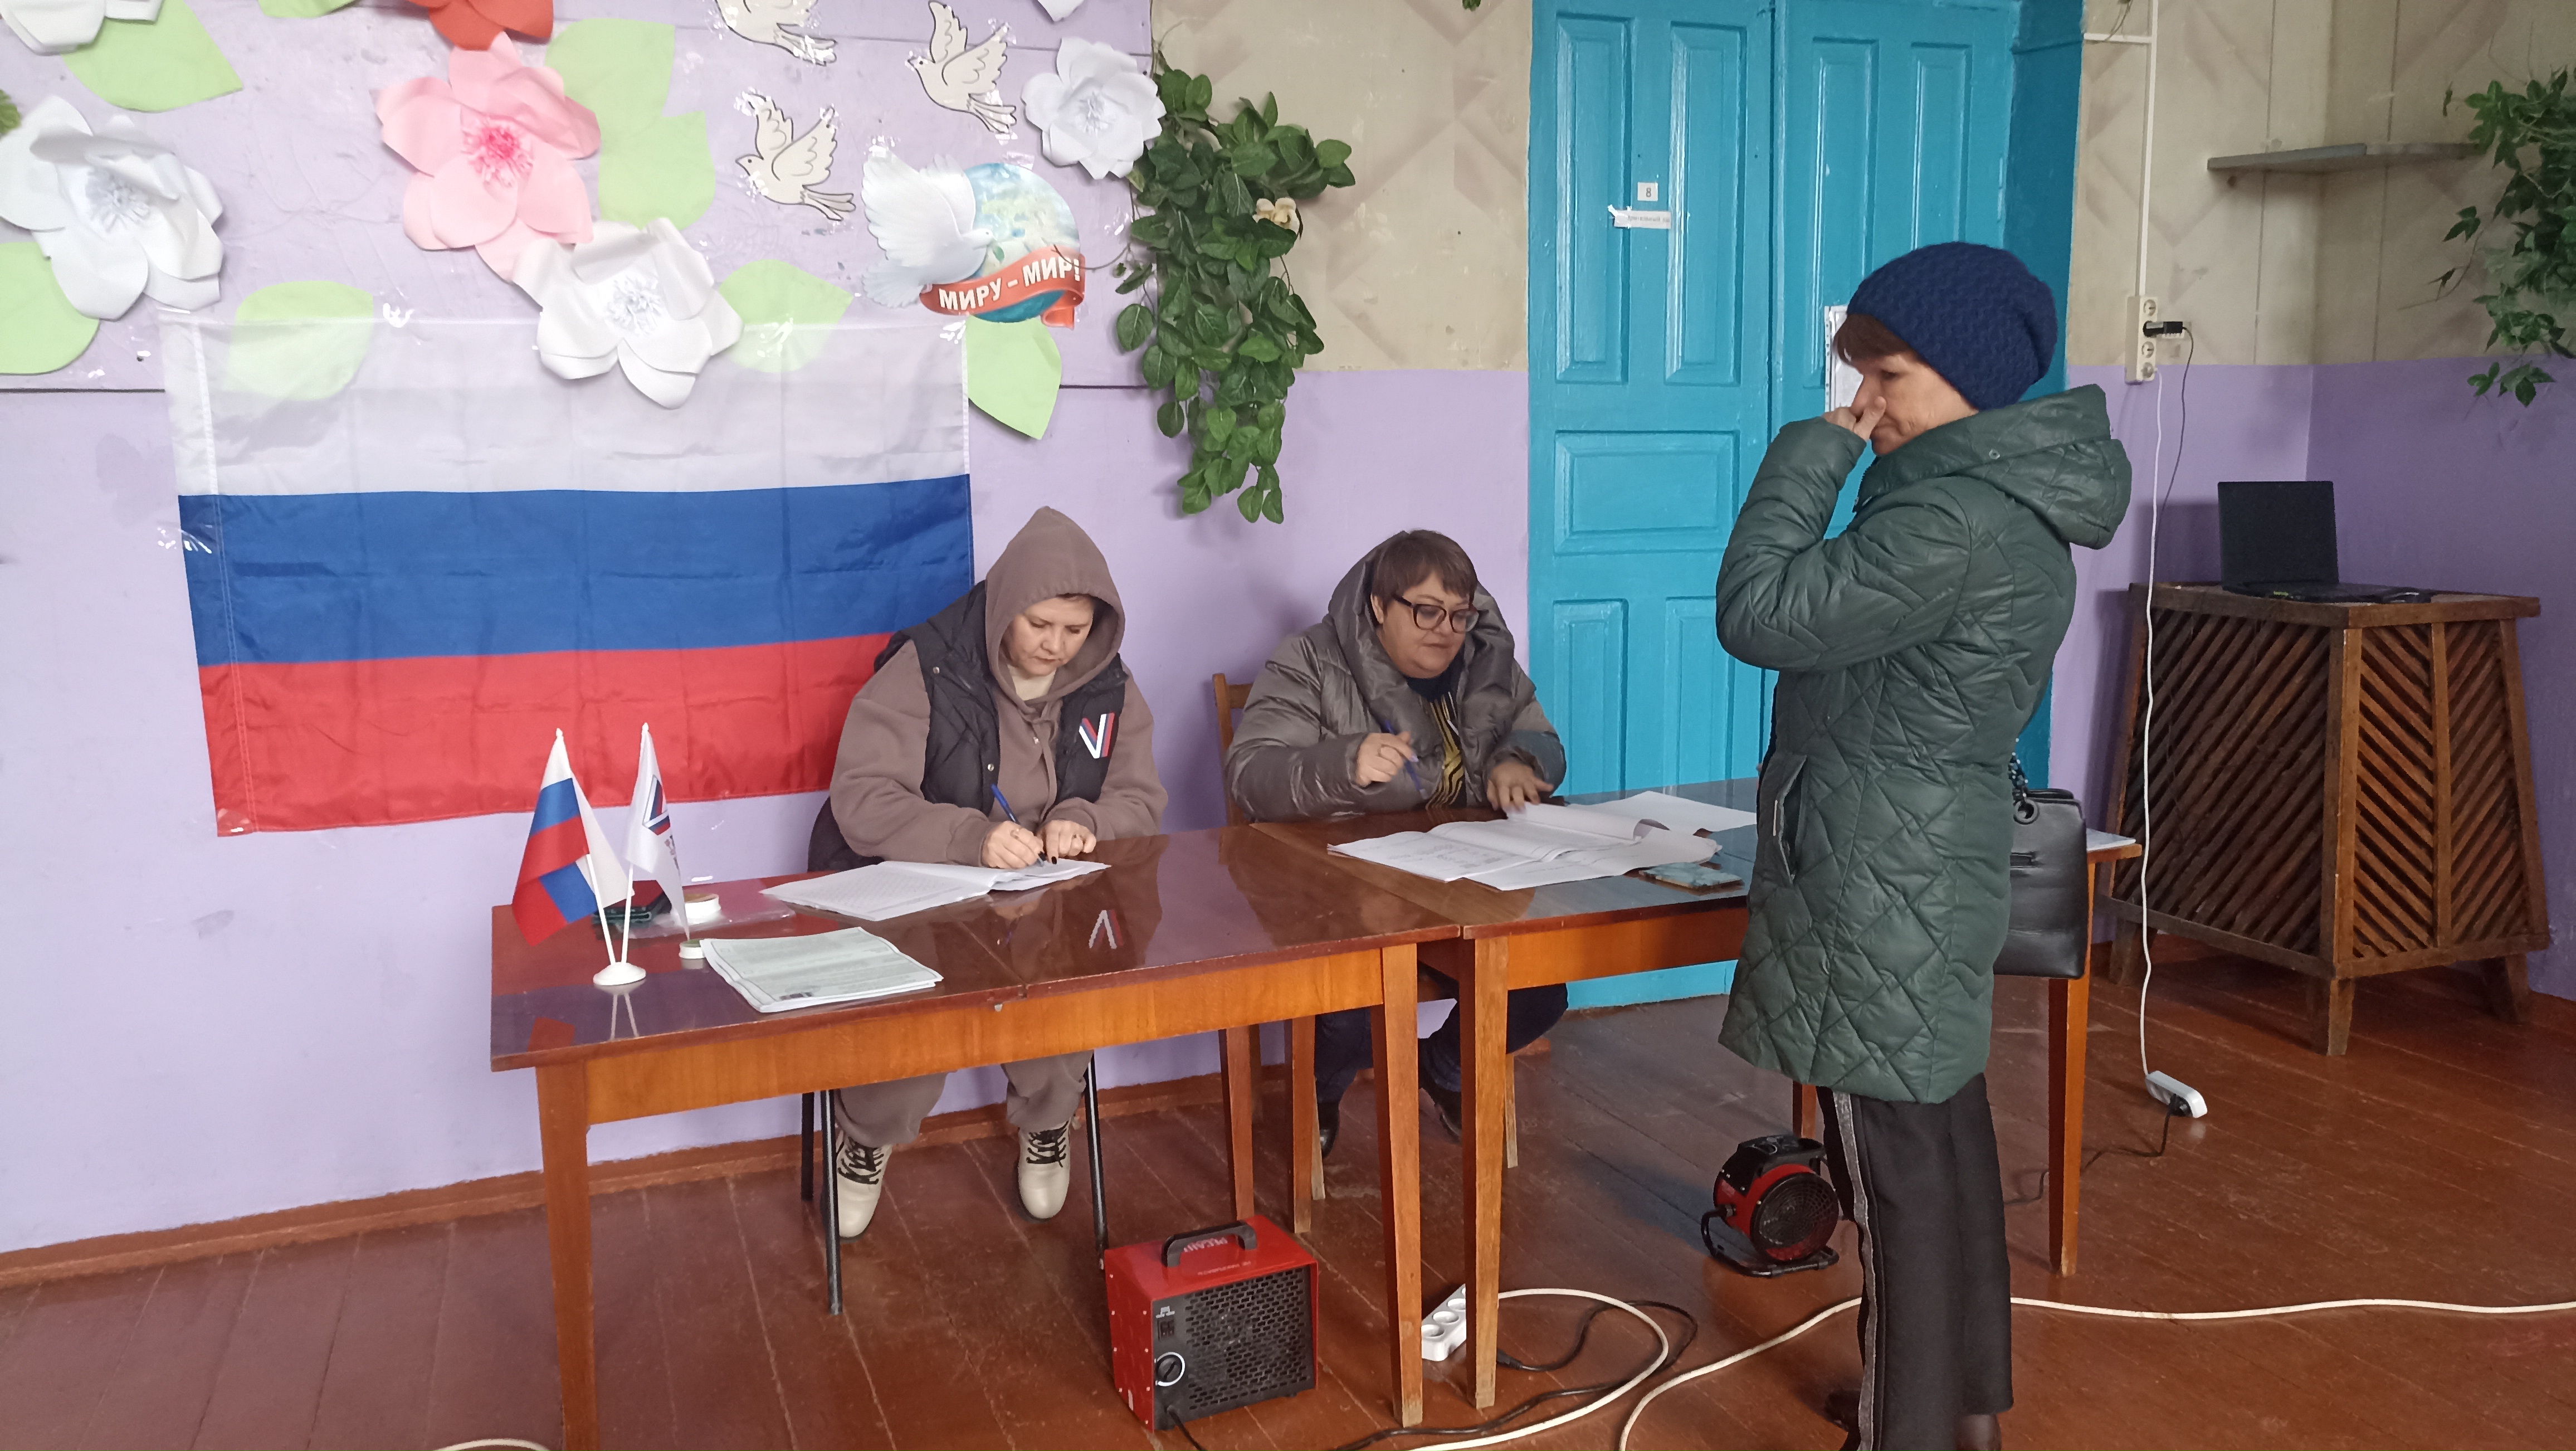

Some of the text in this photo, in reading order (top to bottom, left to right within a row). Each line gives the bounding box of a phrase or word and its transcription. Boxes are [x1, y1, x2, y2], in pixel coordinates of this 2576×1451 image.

[1646, 187, 1651, 197] 8
[939, 277, 1001, 310] МИРУ
[1022, 256, 1080, 286] МИР!
